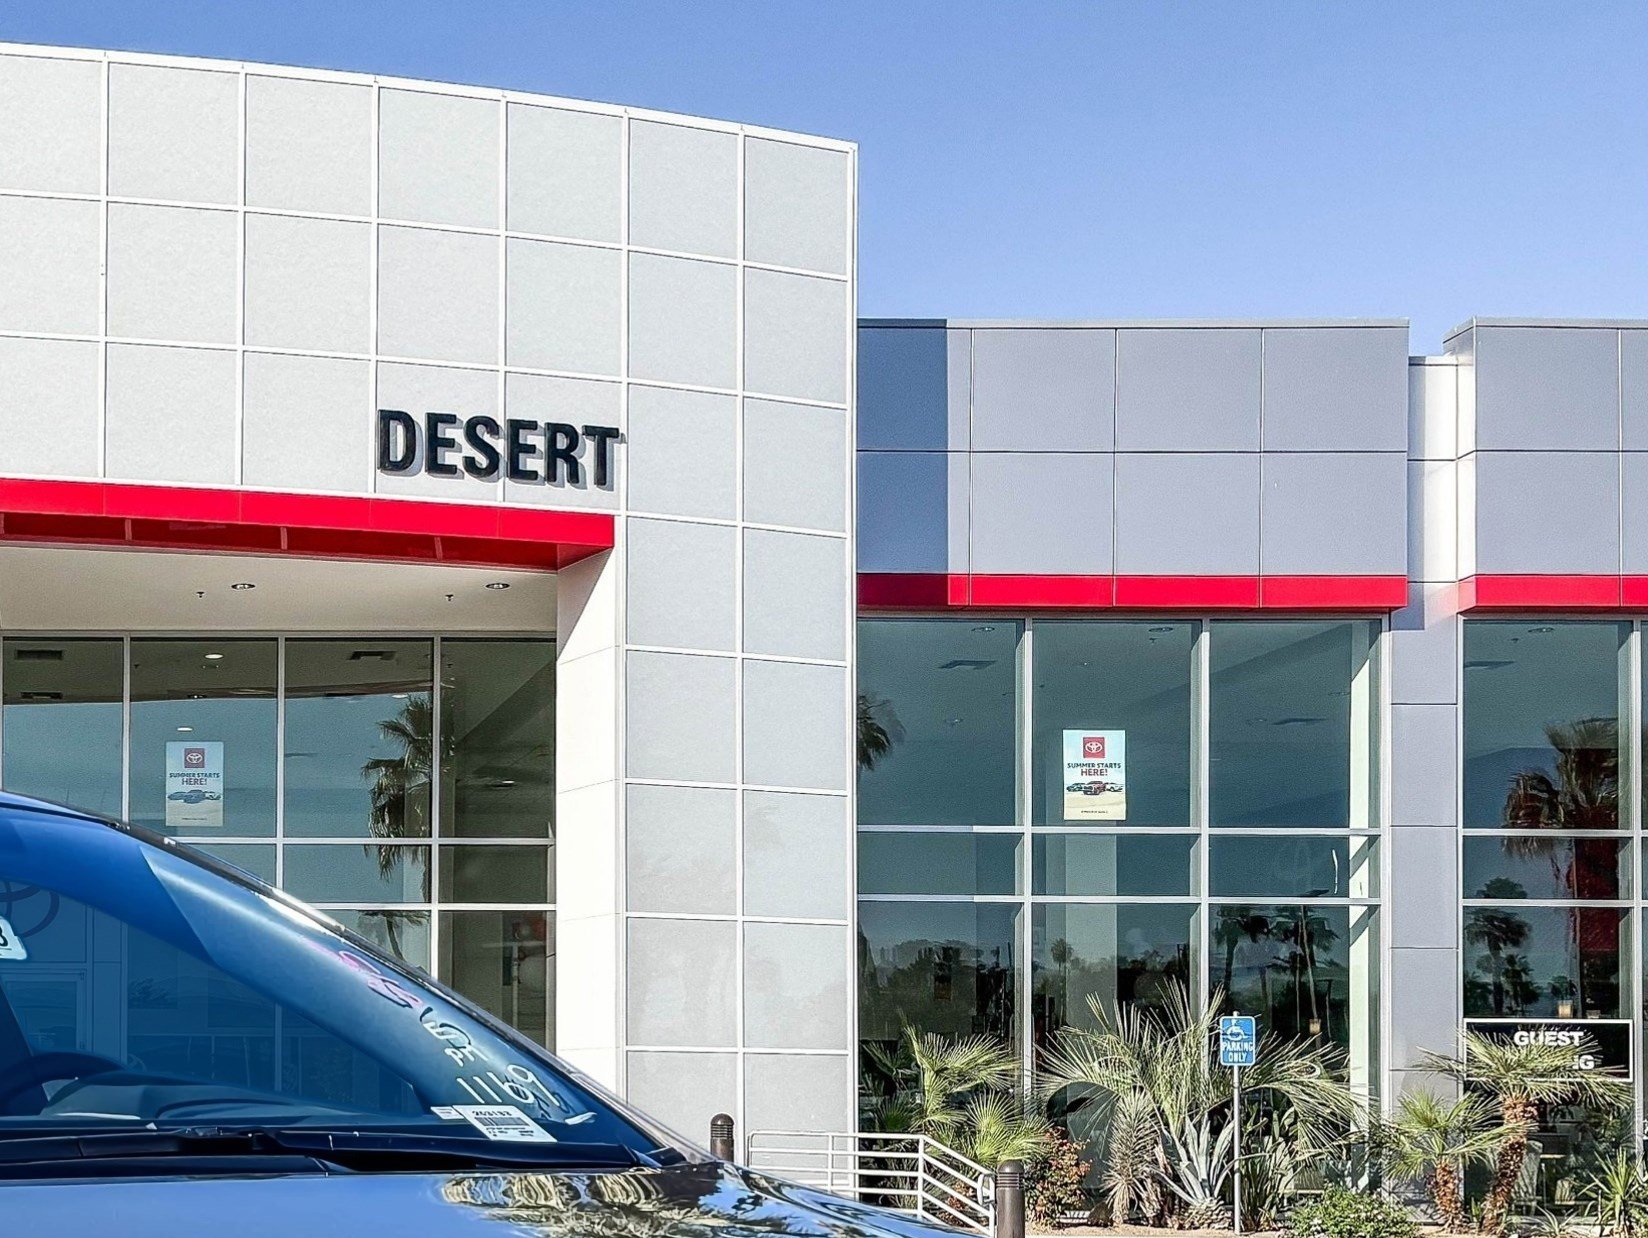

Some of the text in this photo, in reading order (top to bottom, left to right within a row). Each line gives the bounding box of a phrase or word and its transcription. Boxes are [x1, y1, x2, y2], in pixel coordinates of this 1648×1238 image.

[377, 409, 620, 486] DESERT
[181, 778, 207, 786] HERE!
[1513, 1031, 1584, 1046] GUEST
[1222, 1041, 1253, 1051] PARKING
[1228, 1052, 1247, 1062] ONLY
